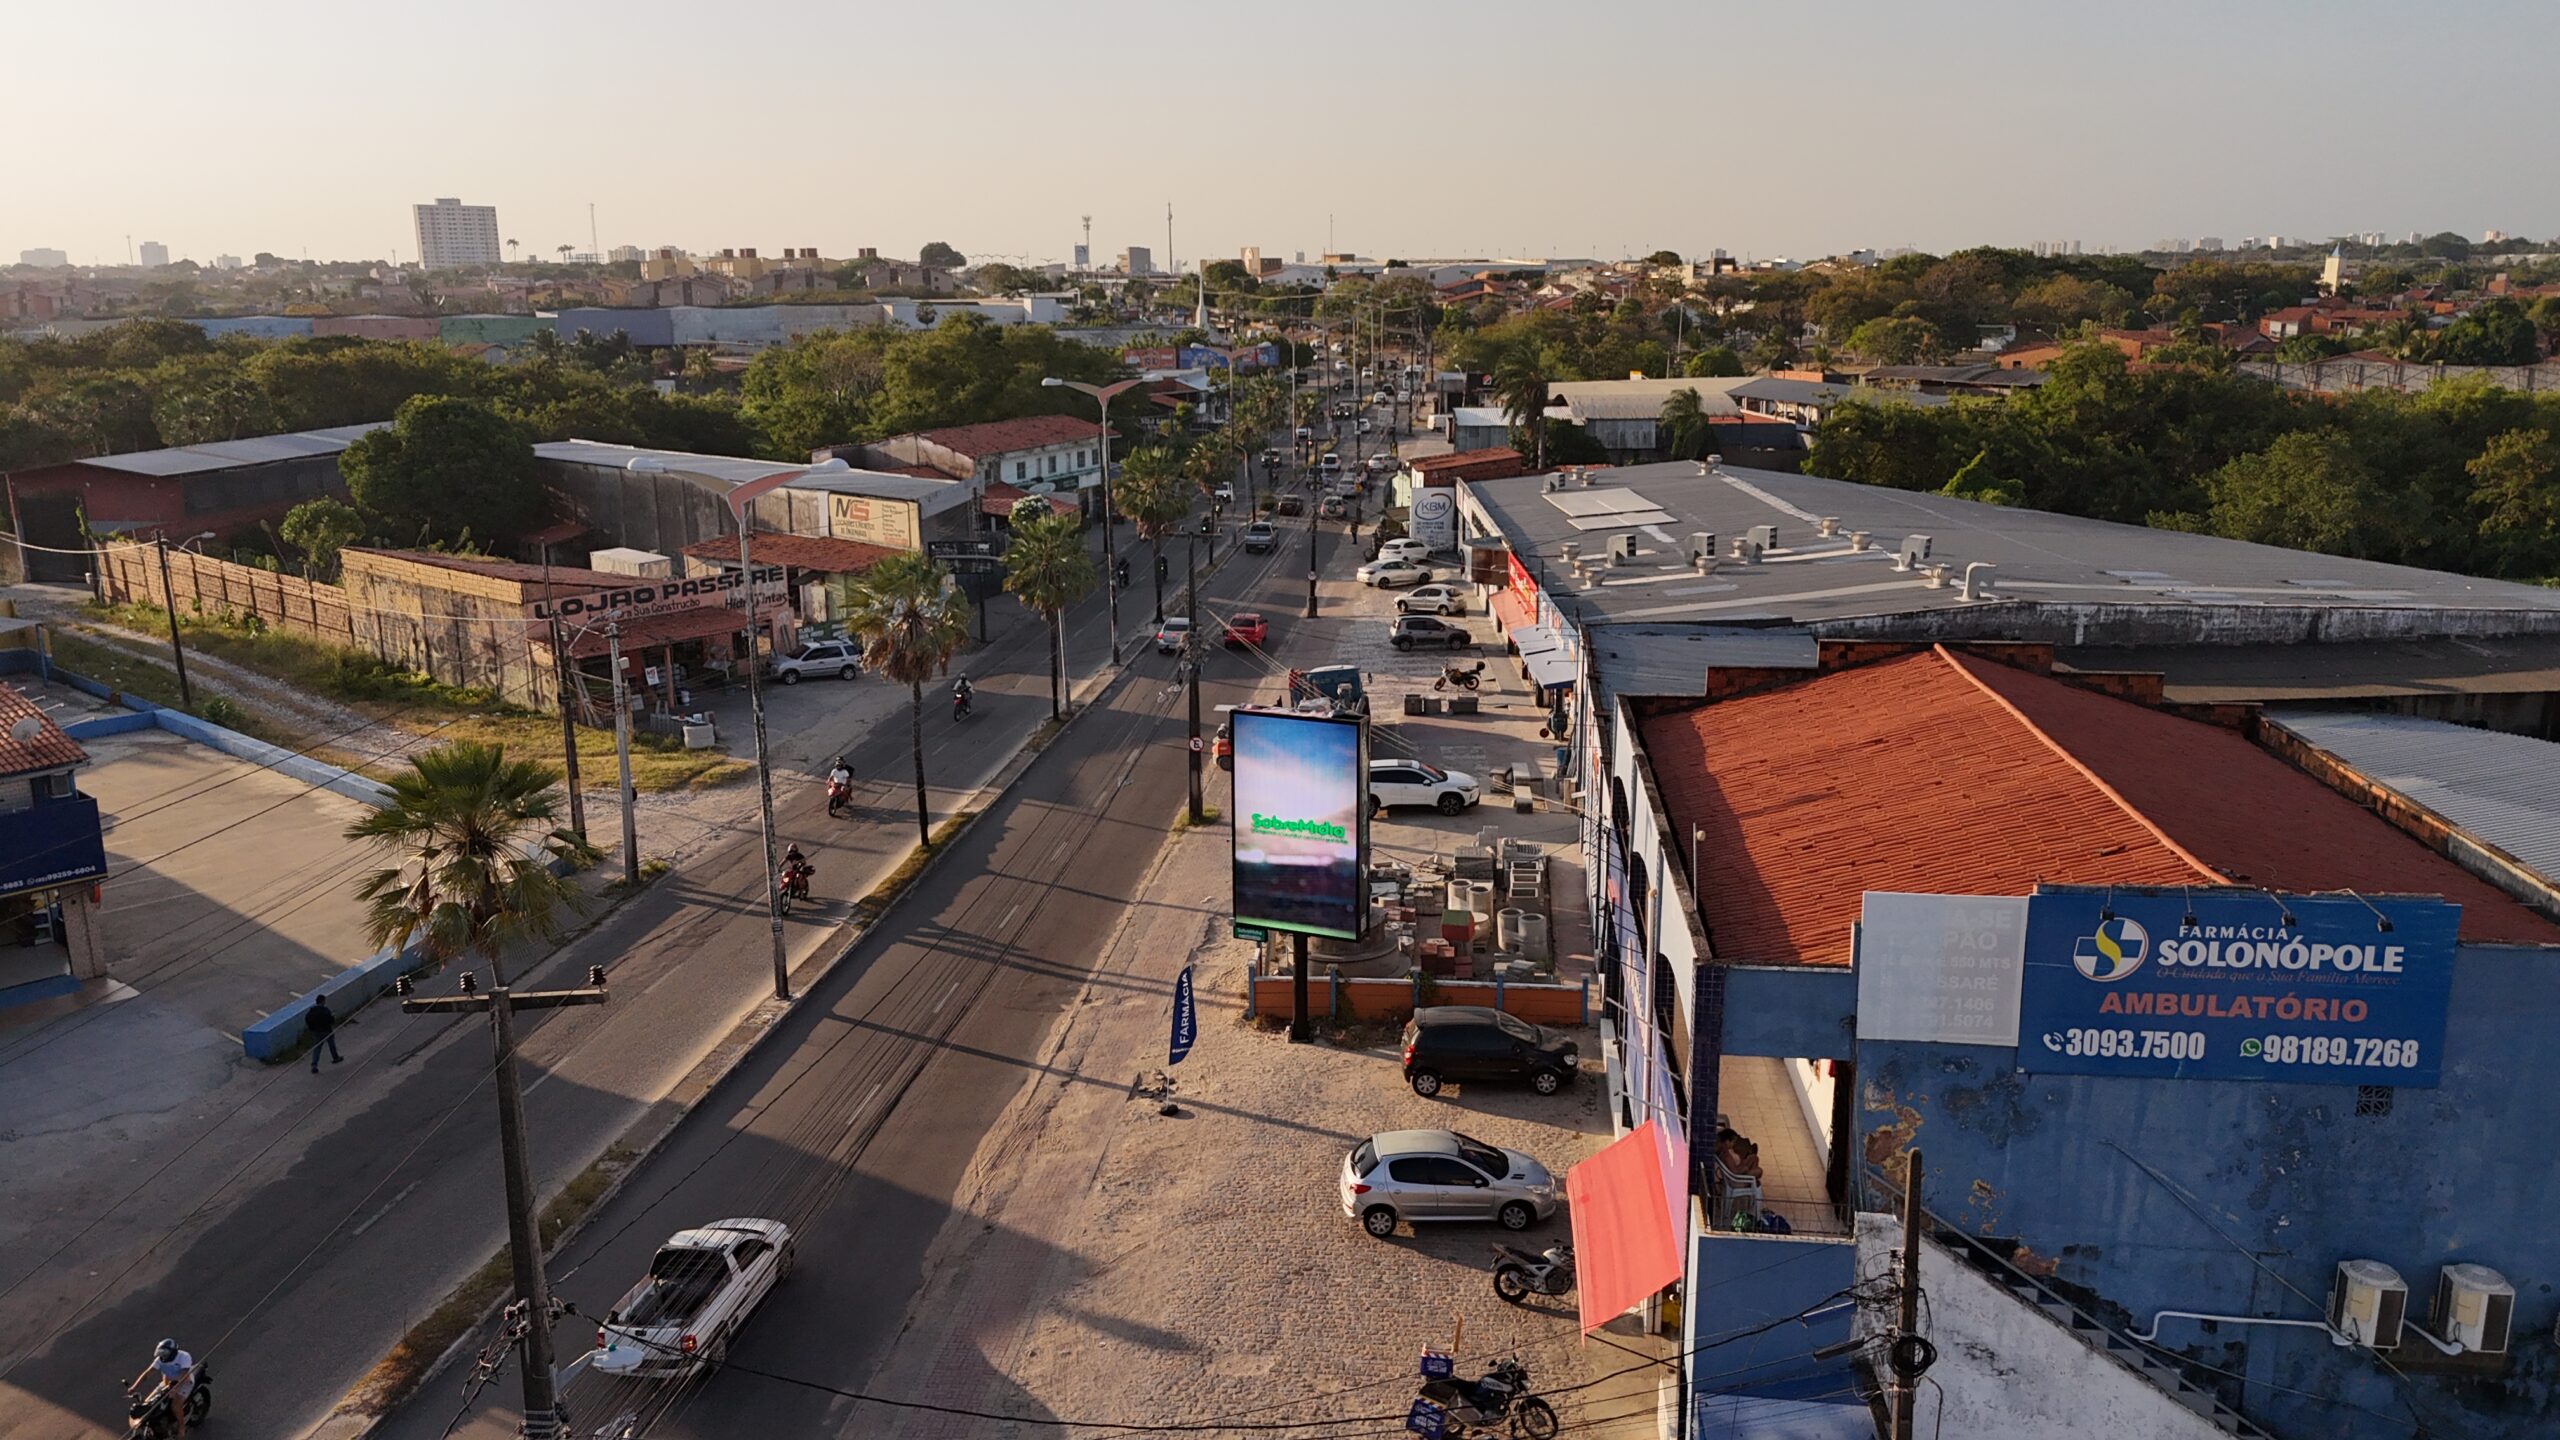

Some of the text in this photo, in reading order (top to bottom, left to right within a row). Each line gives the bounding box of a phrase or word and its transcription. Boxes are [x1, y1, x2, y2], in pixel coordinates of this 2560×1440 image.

[1421, 501, 1447, 512] KBM
[2178, 923, 2289, 941] FARMÁCIA
[1979, 958, 2012, 970] MTS
[2157, 935, 2405, 973] SOLONÓPOLE
[2099, 990, 2368, 1022] AMBULATÓRIO
[2065, 1028, 2420, 1068] 3093.7500 98189.7268
